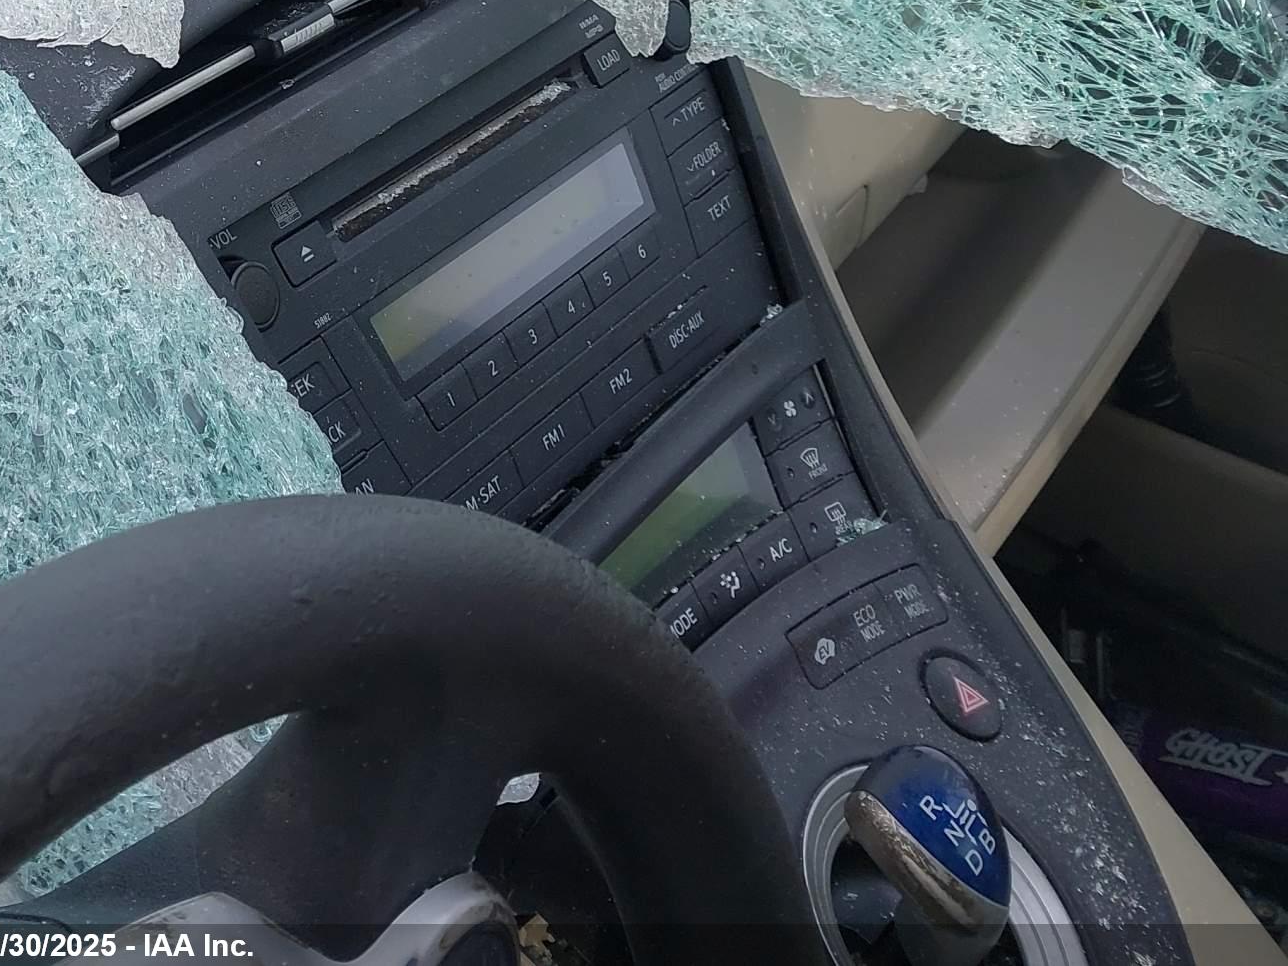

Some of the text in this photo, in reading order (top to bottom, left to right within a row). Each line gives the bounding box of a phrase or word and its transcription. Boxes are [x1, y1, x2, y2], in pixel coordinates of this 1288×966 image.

[597, 49, 621, 71] LOAD
[680, 96, 705, 121] TYPE
[692, 141, 722, 170] FOLDER
[707, 195, 731, 221] TEXT
[637, 244, 647, 259] 6
[602, 271, 612, 286] 5
[567, 300, 576, 314] 4
[528, 328, 538, 344] 3
[487, 360, 498, 377] 2
[609, 368, 633, 394] FM2
[447, 392, 456, 407] 1
[542, 424, 565, 451] FM1
[464, 475, 502, 512] M·SAT
[770, 537, 793, 562] A/C
[894, 584, 922, 605] PWR
[853, 604, 876, 627] ECO
[819, 642, 832, 660] EV
[1164, 727, 1288, 784] GHOST
[919, 795, 944, 821] R
[943, 819, 966, 847] N
[978, 828, 996, 855] B
[965, 849, 984, 876] D
